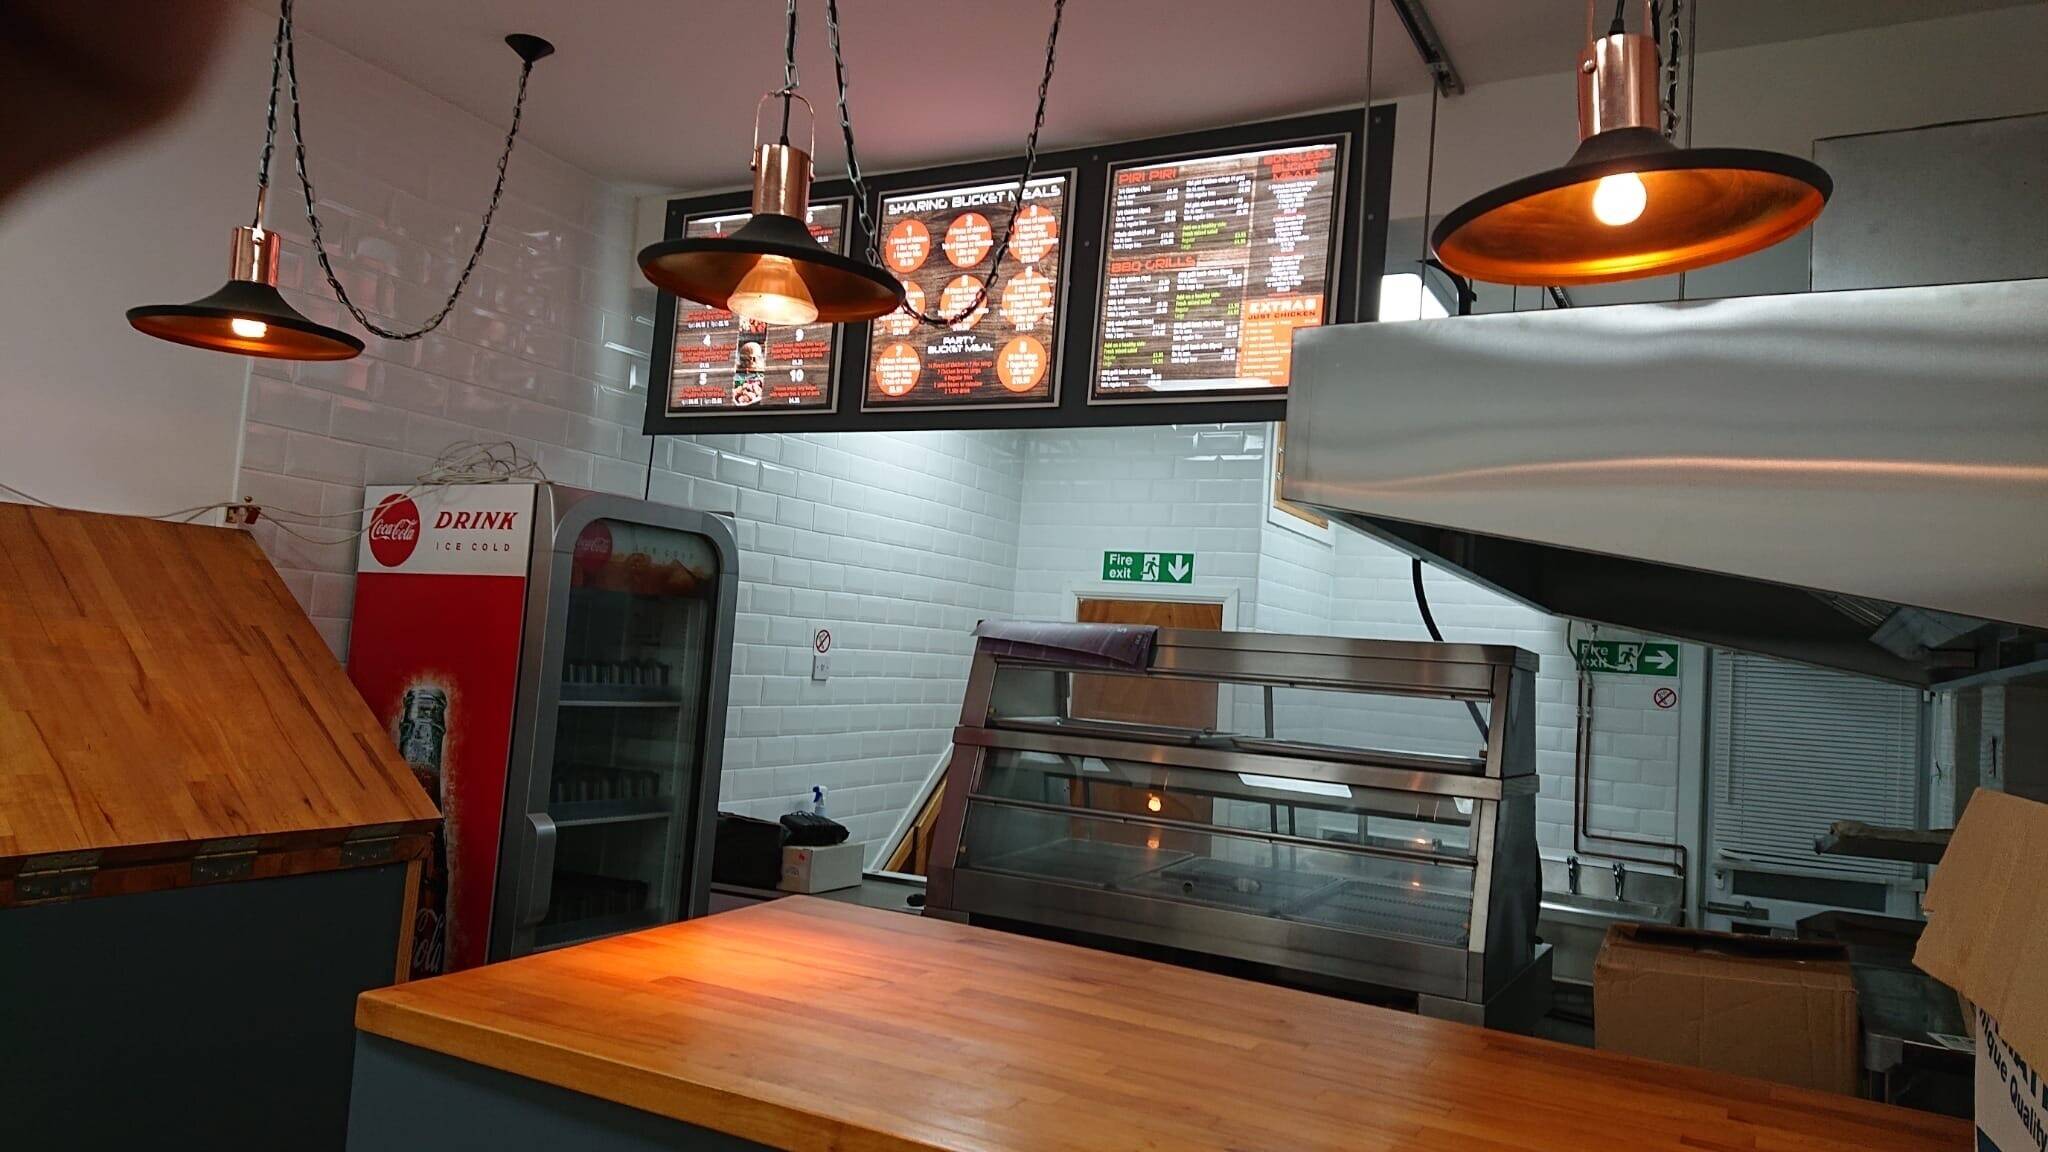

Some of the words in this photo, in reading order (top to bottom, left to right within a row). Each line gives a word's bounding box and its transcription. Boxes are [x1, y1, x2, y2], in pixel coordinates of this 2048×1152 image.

[1118, 172, 1145, 184] PIRI
[1148, 168, 1177, 181] PIRI
[887, 198, 948, 216] SHARING
[952, 191, 1007, 209] BUCKET
[1111, 261, 1141, 273] BBQ
[1145, 256, 1196, 270] GRILLS
[1249, 298, 1317, 313] EXTRAS
[1274, 310, 1316, 319] CHICKEN
[703, 334, 711, 347] 4
[796, 328, 804, 342] 9
[943, 336, 976, 346] PARTY
[928, 344, 963, 354] BUCKET
[965, 342, 993, 353] MEAL
[790, 369, 804, 382] 10
[433, 511, 519, 530] DRINK
[436, 542, 461, 551] ICE
[472, 542, 510, 551] COLD
[1109, 553, 1133, 566] Fire
[1109, 567, 1131, 579] exit
[1979, 1007, 2008, 1083] nique
[2010, 1075, 2048, 1152] Quality
